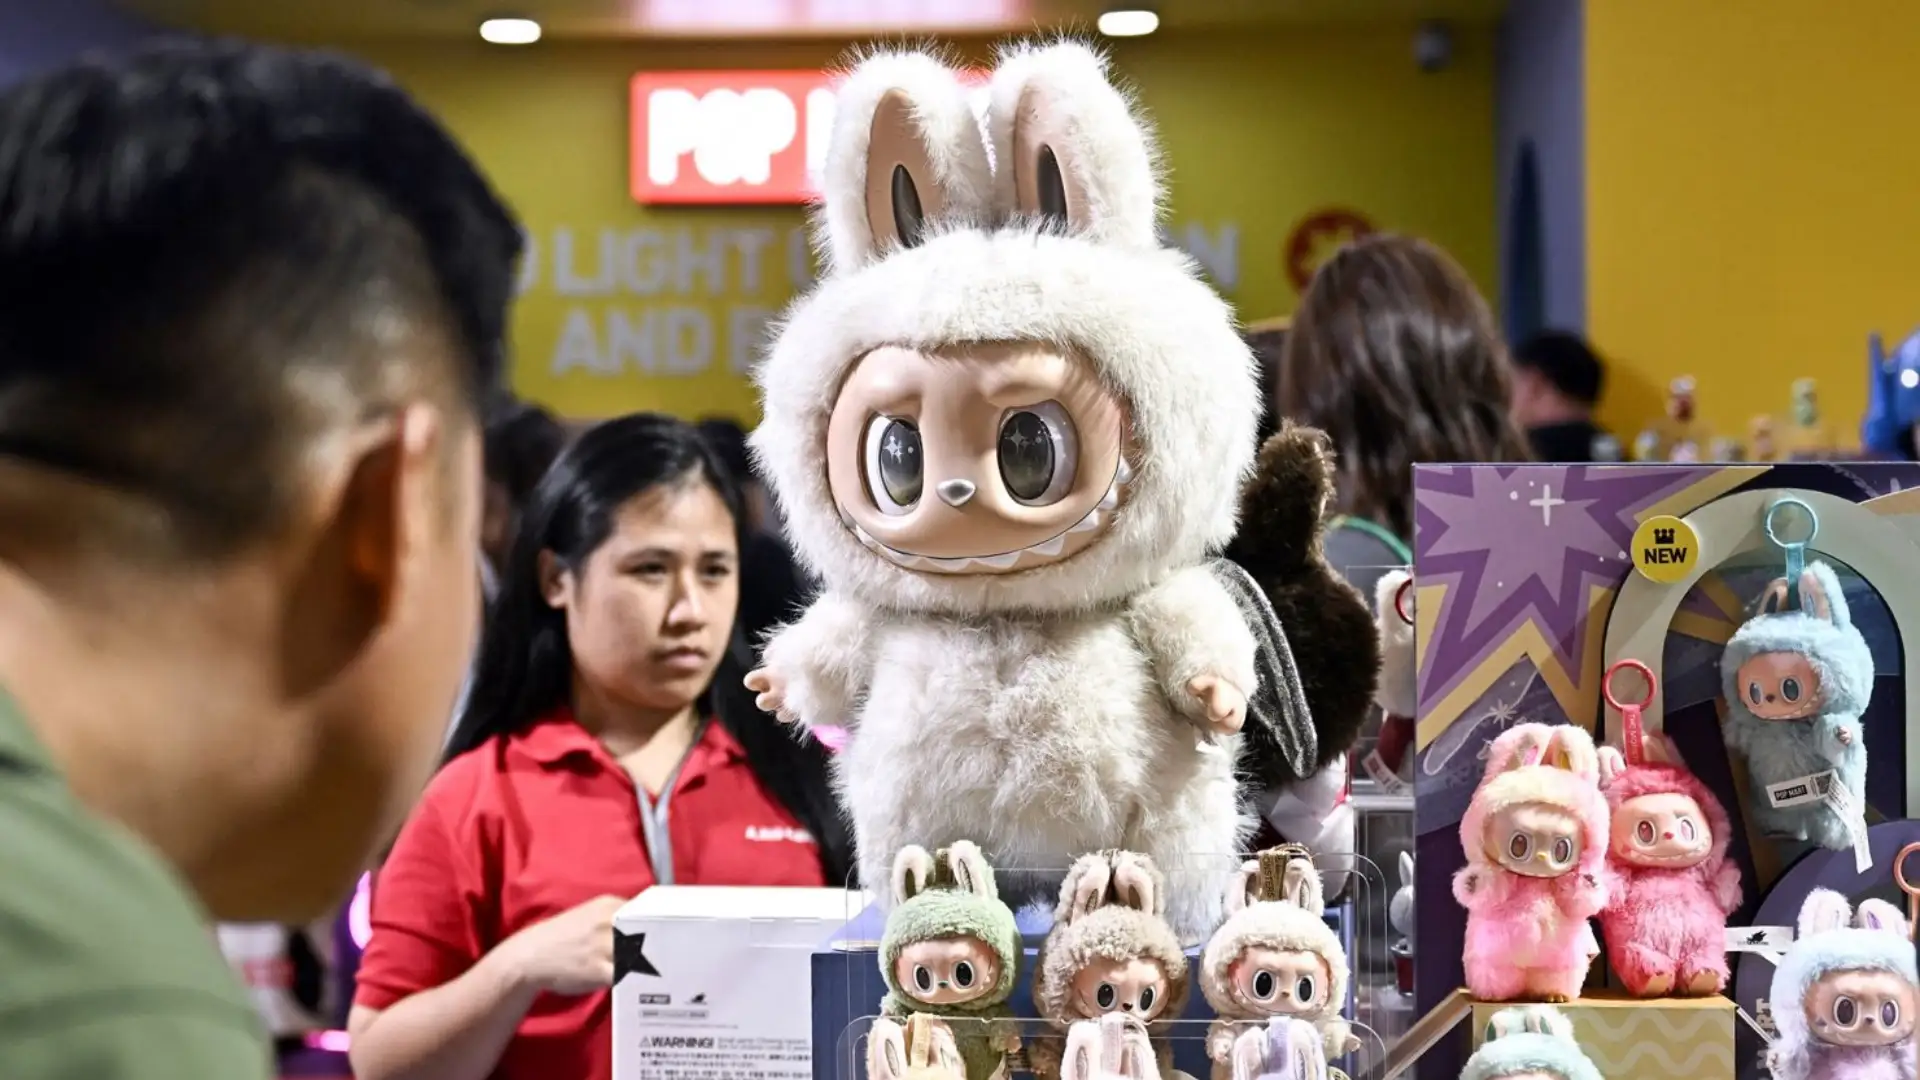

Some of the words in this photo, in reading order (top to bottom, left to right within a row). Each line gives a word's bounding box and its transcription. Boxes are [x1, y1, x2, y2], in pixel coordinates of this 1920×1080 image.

[648, 88, 797, 185] POP
[554, 227, 777, 296] LIGHT
[553, 306, 714, 378] AND
[1644, 547, 1687, 564] NEW
[651, 1036, 715, 1049] WARNING!
